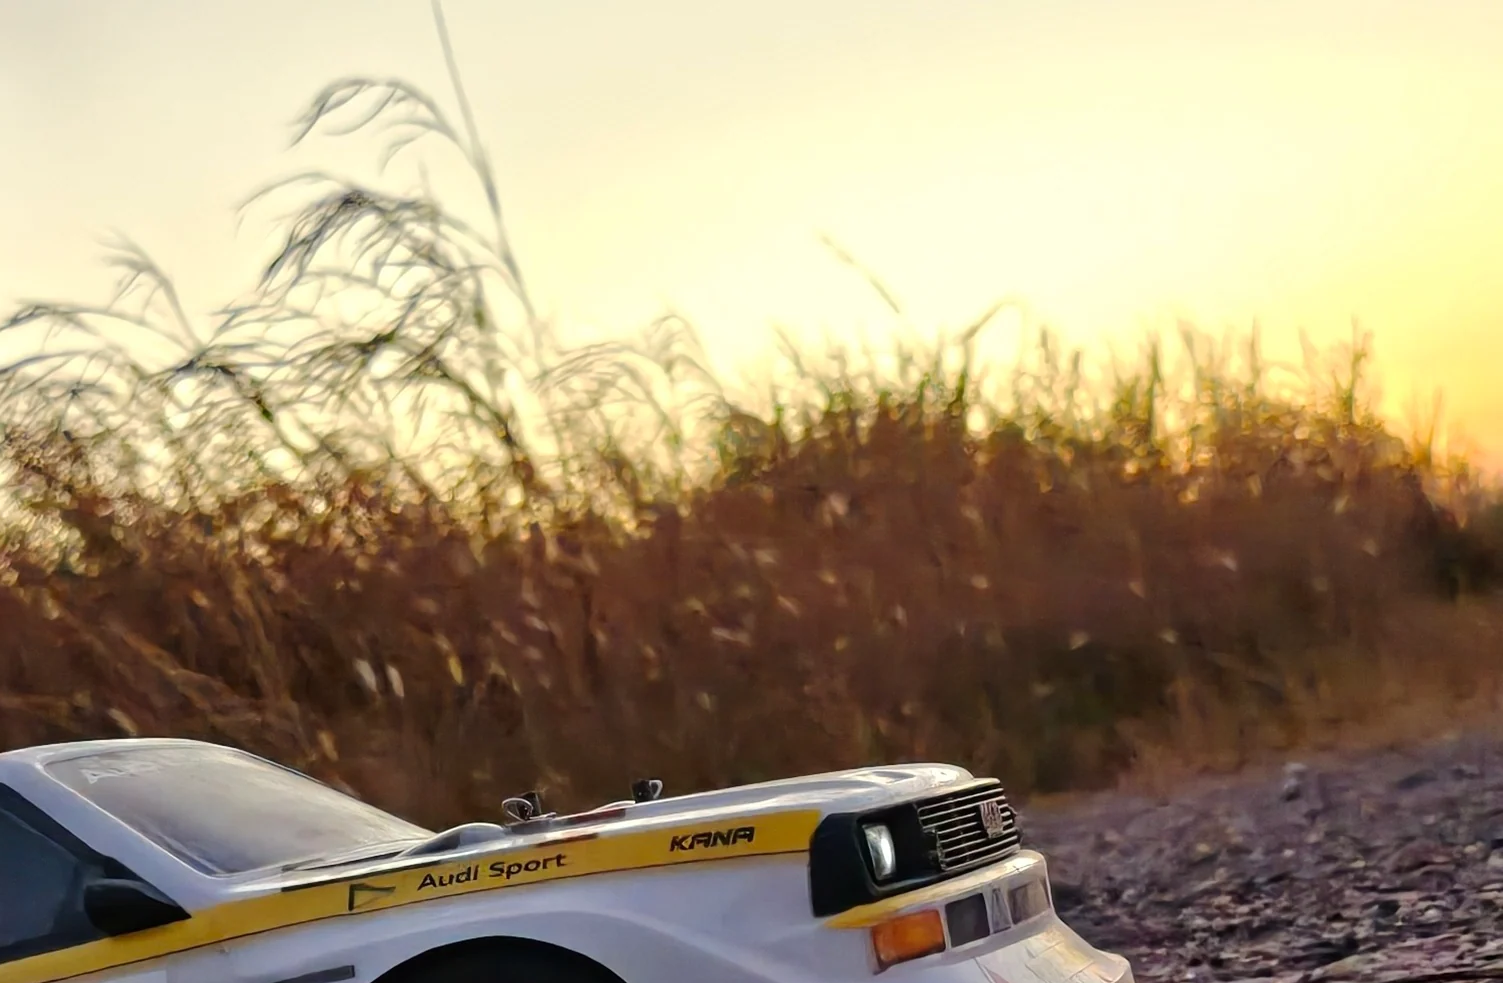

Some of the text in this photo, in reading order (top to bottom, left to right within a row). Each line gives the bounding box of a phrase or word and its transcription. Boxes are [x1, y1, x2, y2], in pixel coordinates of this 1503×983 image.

[670, 826, 755, 852] KANA
[417, 853, 567, 890] Audi Sport
